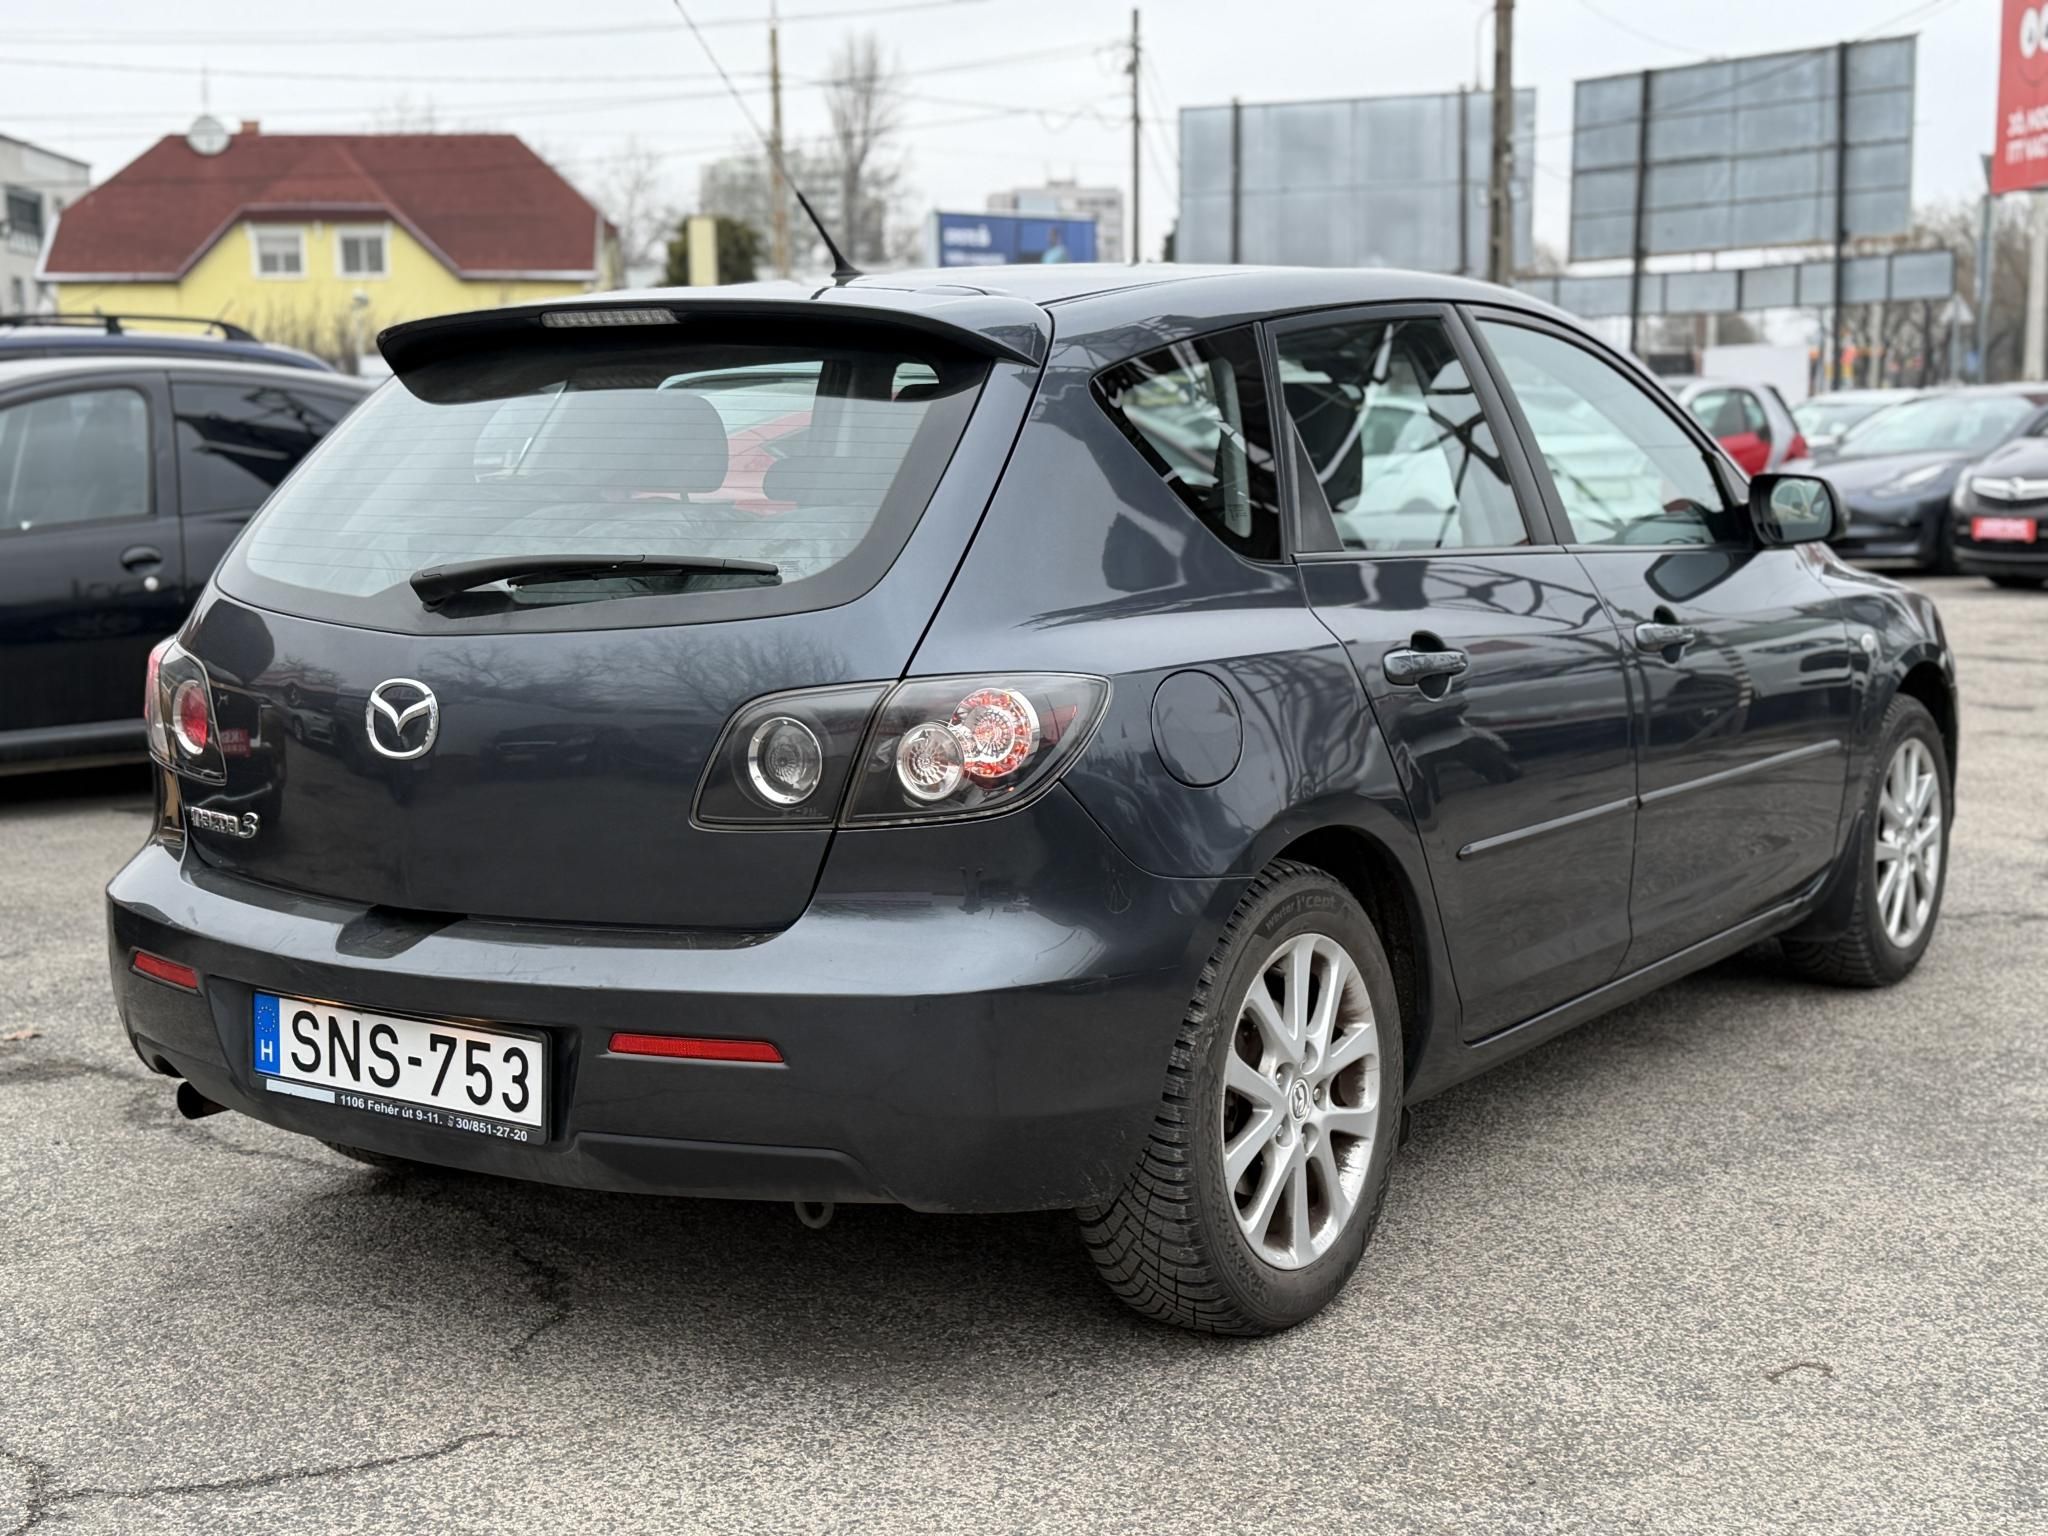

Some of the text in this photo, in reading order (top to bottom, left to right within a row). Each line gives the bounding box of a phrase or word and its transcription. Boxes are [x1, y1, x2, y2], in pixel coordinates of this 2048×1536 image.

[260, 1039, 274, 1063] H
[290, 1009, 530, 1114] SNS-753
[340, 1094, 528, 1142] 1106 Fehér út 9-11. 30/851-27-20
